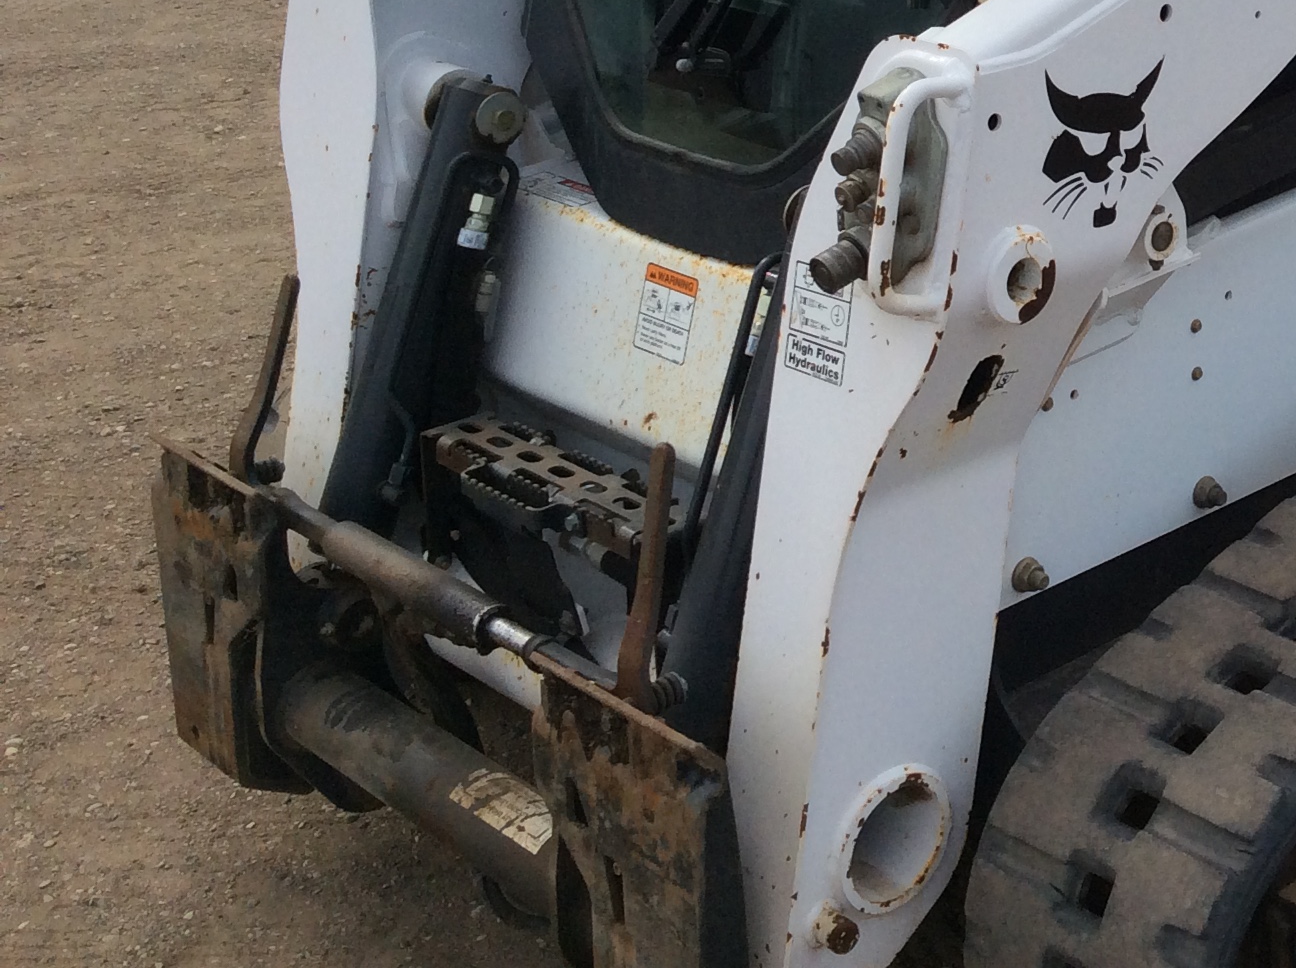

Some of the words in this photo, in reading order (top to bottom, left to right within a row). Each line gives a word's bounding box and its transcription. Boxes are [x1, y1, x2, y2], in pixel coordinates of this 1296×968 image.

[658, 272, 694, 292] WARNING
[791, 338, 813, 356] High
[816, 348, 840, 365] Flow
[789, 352, 839, 380] Hydraulics
